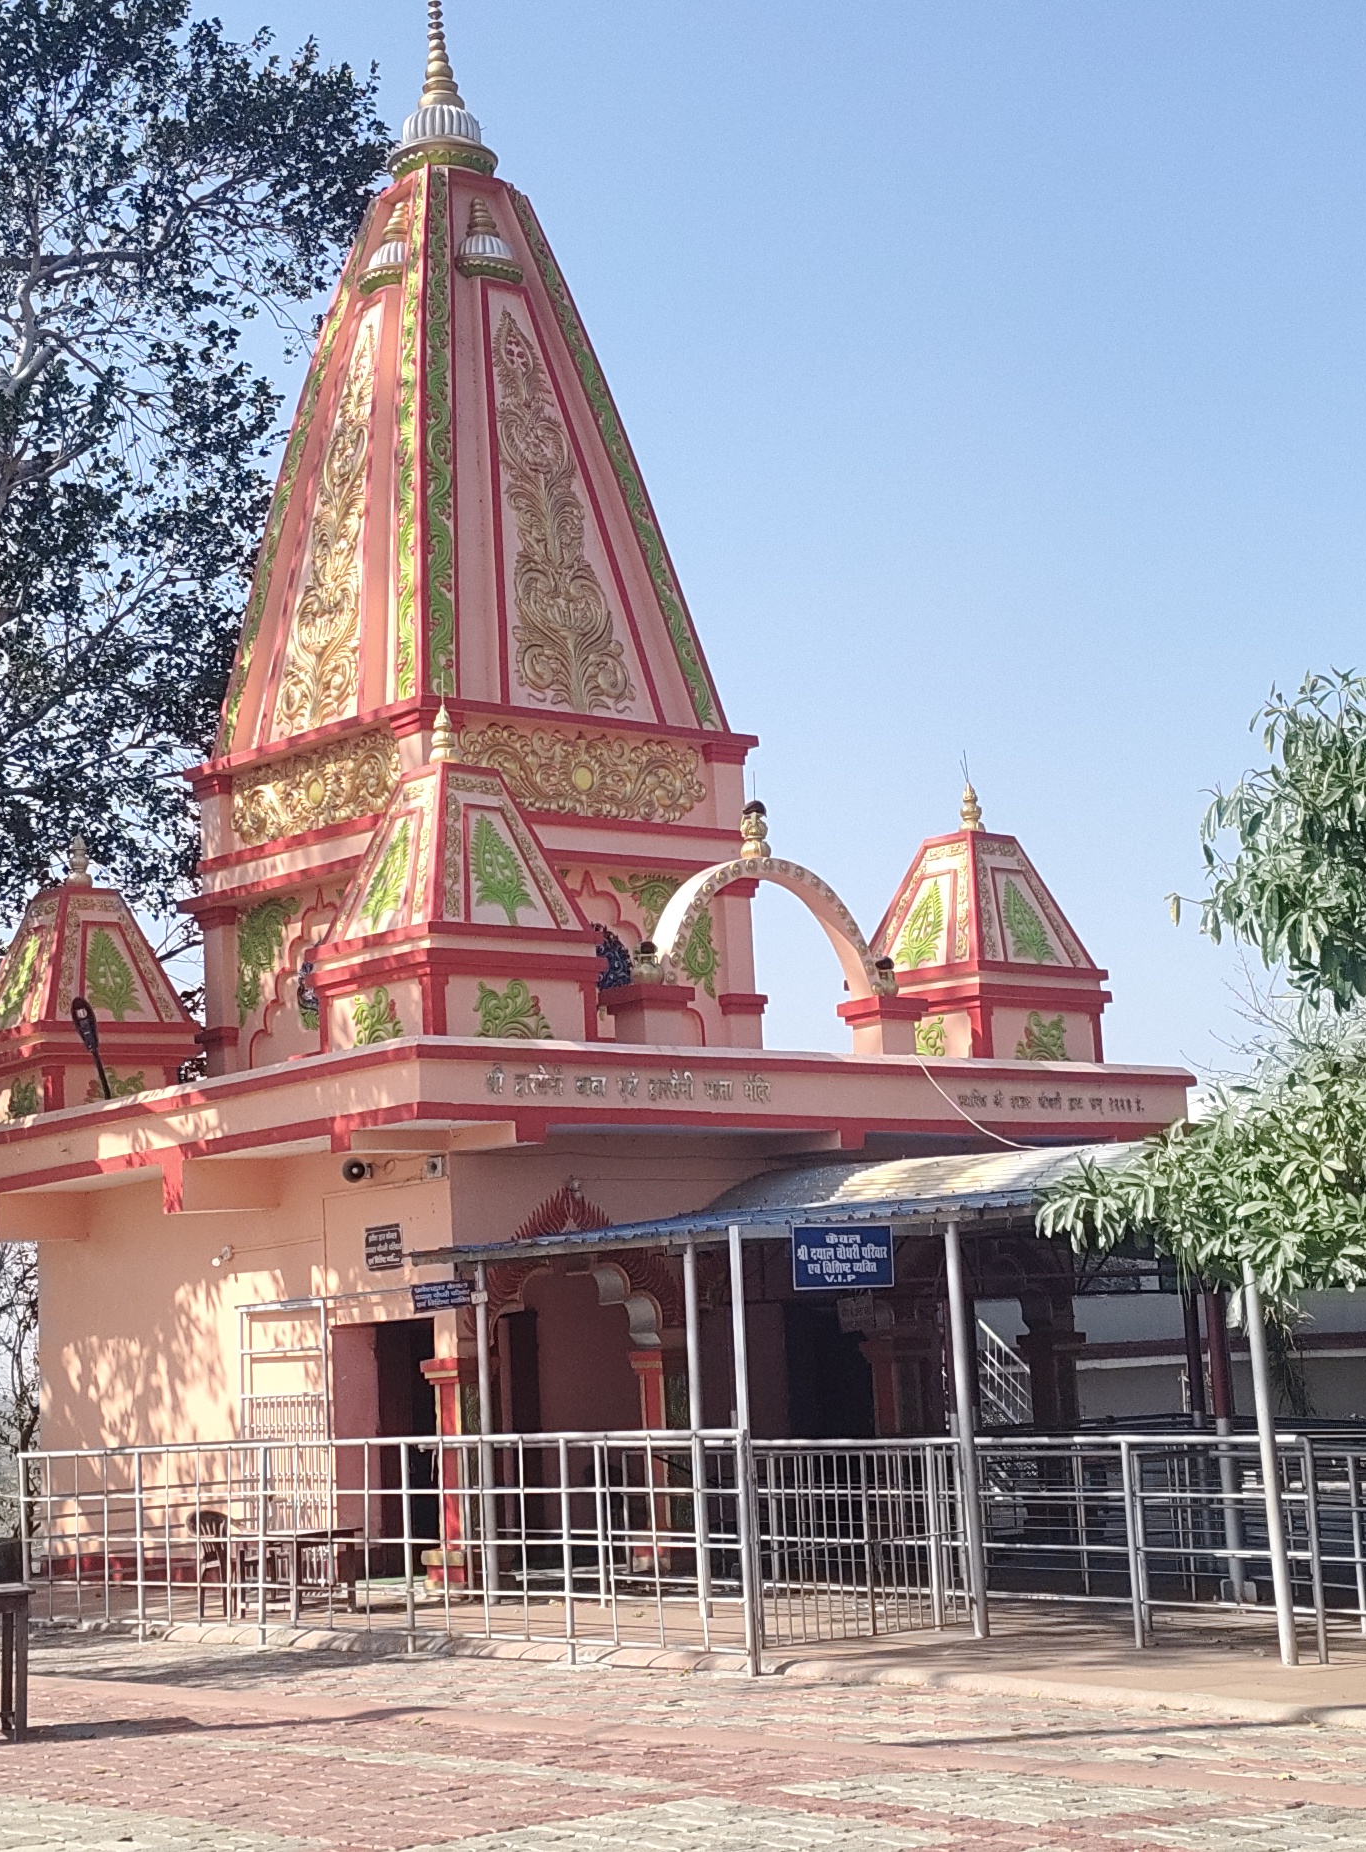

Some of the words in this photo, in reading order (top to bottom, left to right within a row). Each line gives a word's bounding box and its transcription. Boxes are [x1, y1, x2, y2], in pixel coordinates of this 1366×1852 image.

[825, 1232, 861, 1244] केवल
[797, 1244, 808, 1261] श्री
[810, 1247, 835, 1260] दयाल
[836, 1243, 860, 1260] चौधरी
[861, 1243, 888, 1259] परिवार
[807, 1261, 822, 1275] एवं
[822, 1260, 851, 1274] विशिष्ट
